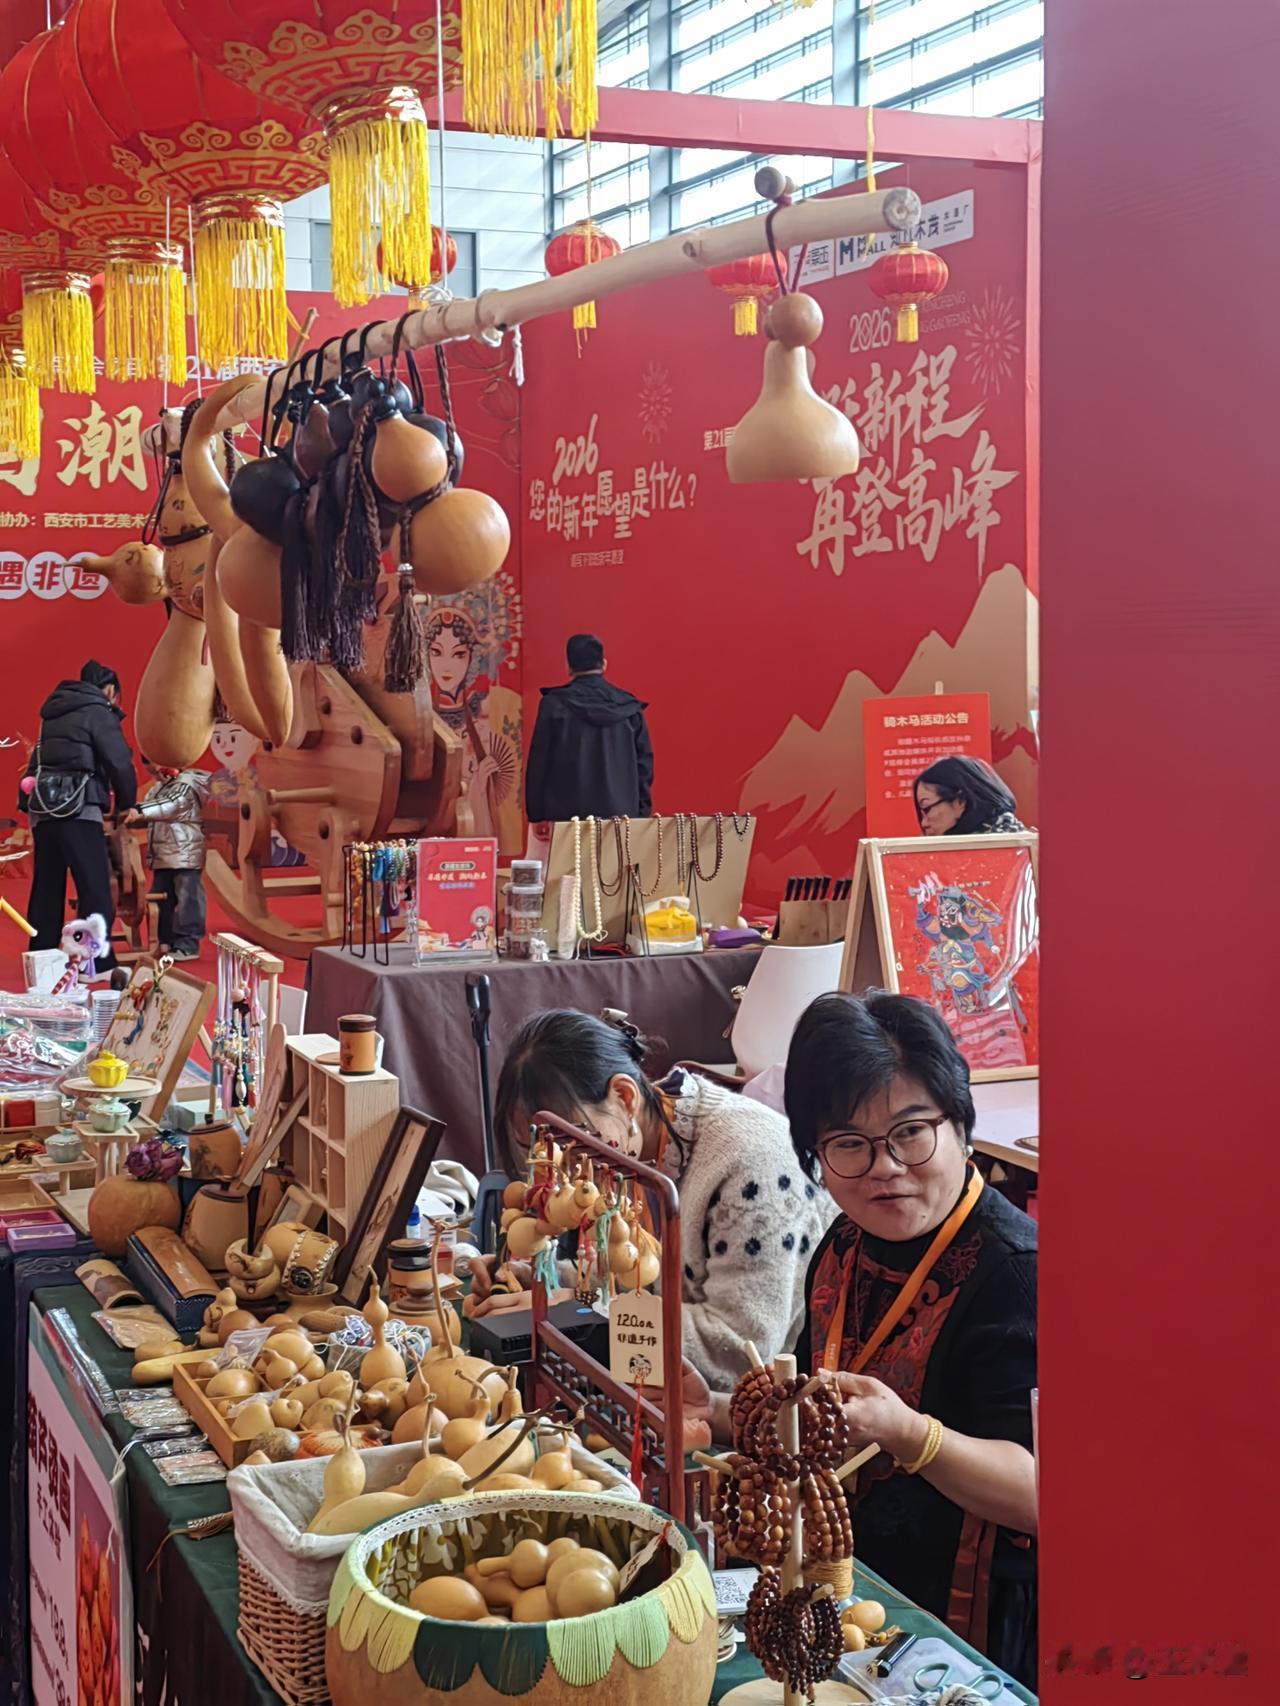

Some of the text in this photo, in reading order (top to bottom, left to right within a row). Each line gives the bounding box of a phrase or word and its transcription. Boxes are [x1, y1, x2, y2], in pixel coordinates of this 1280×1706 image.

[850, 307, 892, 353] 2026
[553, 413, 598, 485] 2026
[797, 431, 1020, 578] 再登高峰
